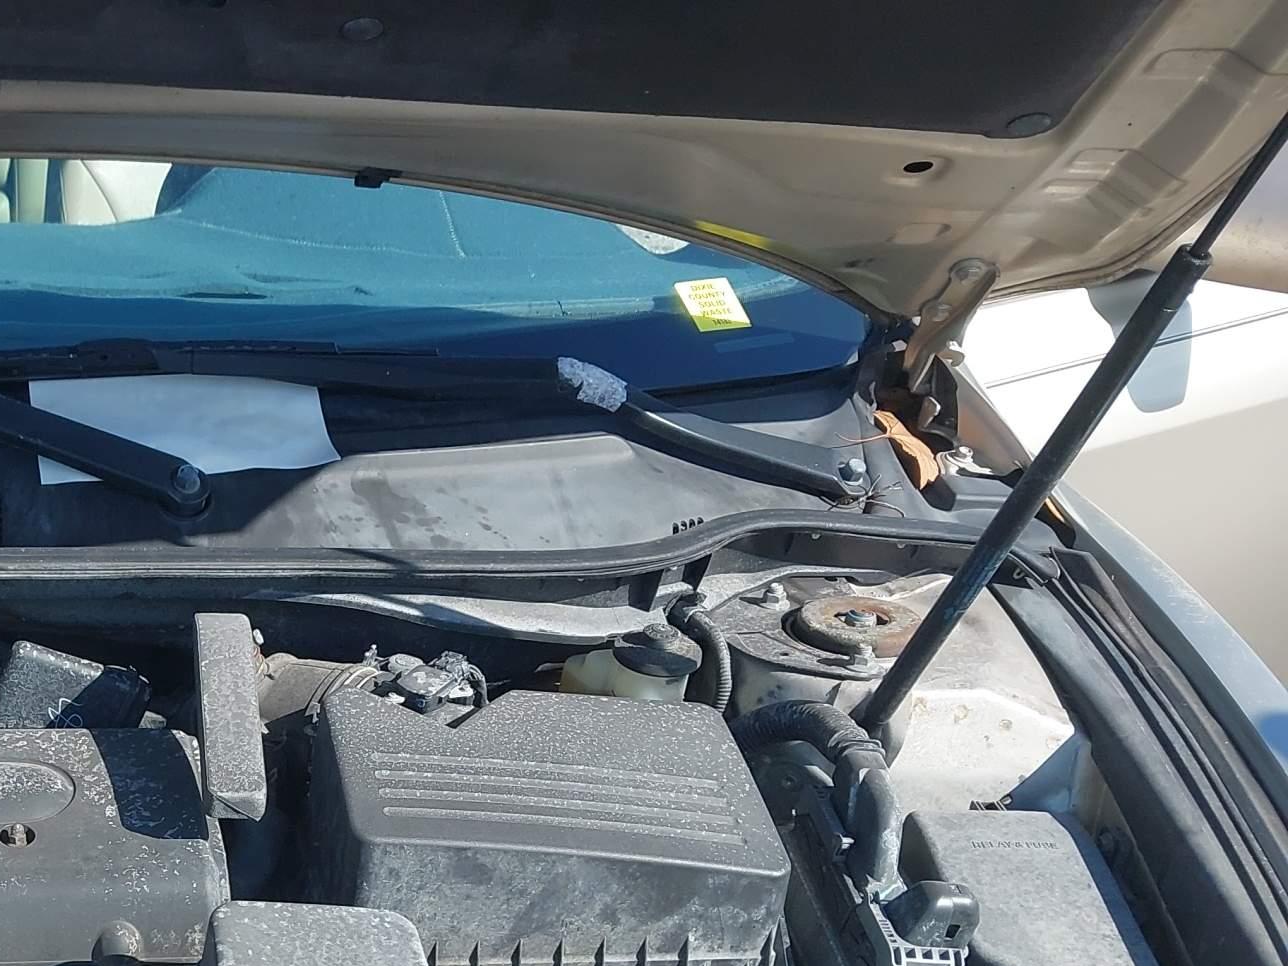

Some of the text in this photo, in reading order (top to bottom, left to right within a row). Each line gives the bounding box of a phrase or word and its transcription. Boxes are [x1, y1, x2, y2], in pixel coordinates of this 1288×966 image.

[690, 283, 715, 291] DIXIE
[688, 291, 725, 300] COUNTY
[698, 300, 726, 308] SOLID
[702, 308, 732, 318] WASTE
